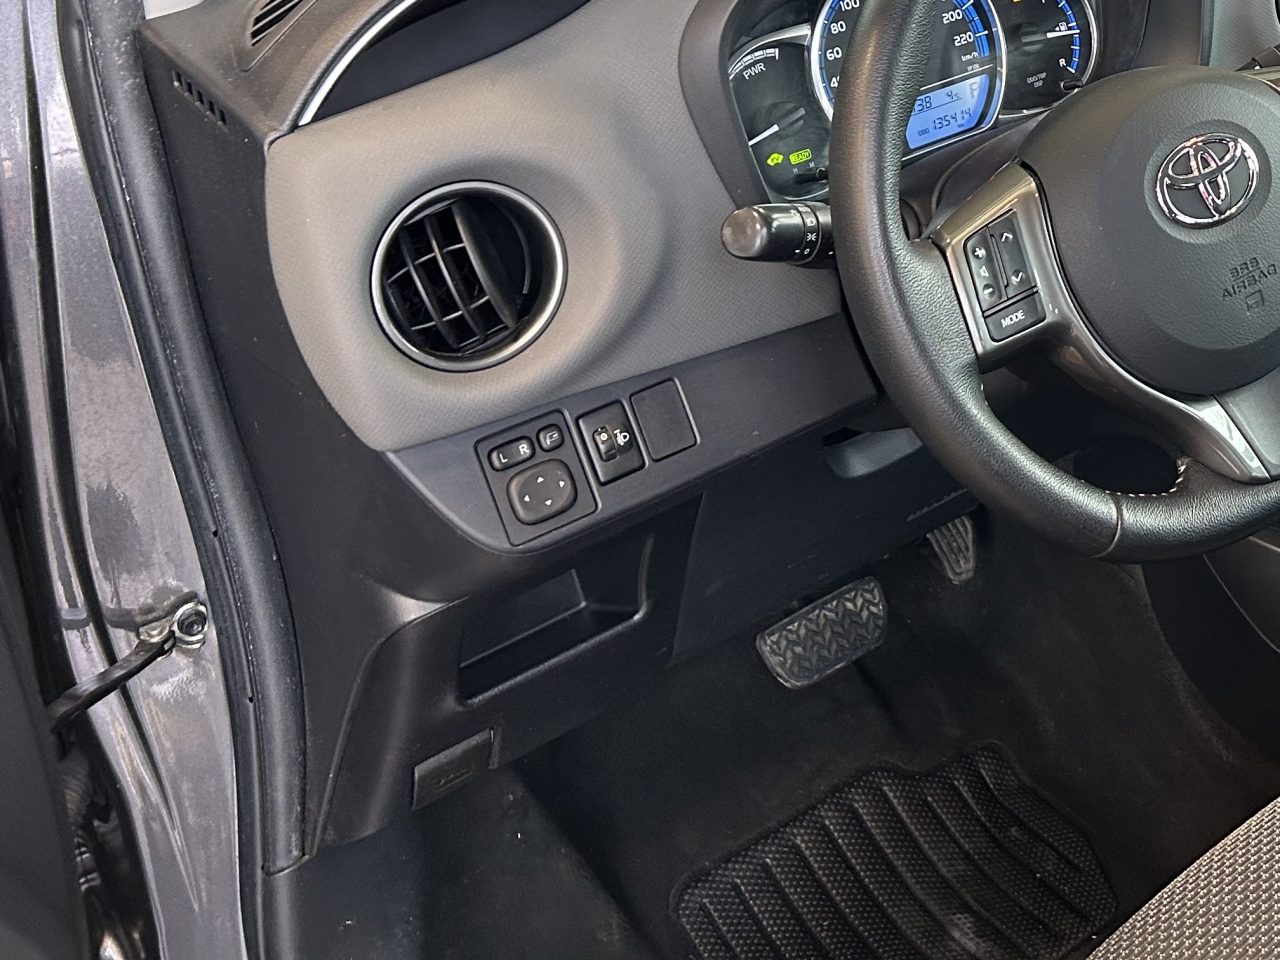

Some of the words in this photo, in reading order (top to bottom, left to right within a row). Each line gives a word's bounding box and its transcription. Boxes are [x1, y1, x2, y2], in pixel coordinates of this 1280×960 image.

[941, 8, 963, 25] 200
[830, 20, 847, 35] 80
[953, 31, 974, 47] 220
[826, 46, 843, 61] 60
[961, 51, 979, 62] km/h
[742, 62, 767, 80] PWR
[1058, 58, 1067, 68] R
[969, 81, 980, 98] P
[932, 106, 972, 131] 135414
[791, 151, 810, 163] READY
[1222, 263, 1278, 301] AIRBAG
[1000, 309, 1026, 328] MODE
[499, 452, 508, 463] L
[518, 443, 530, 456] R
